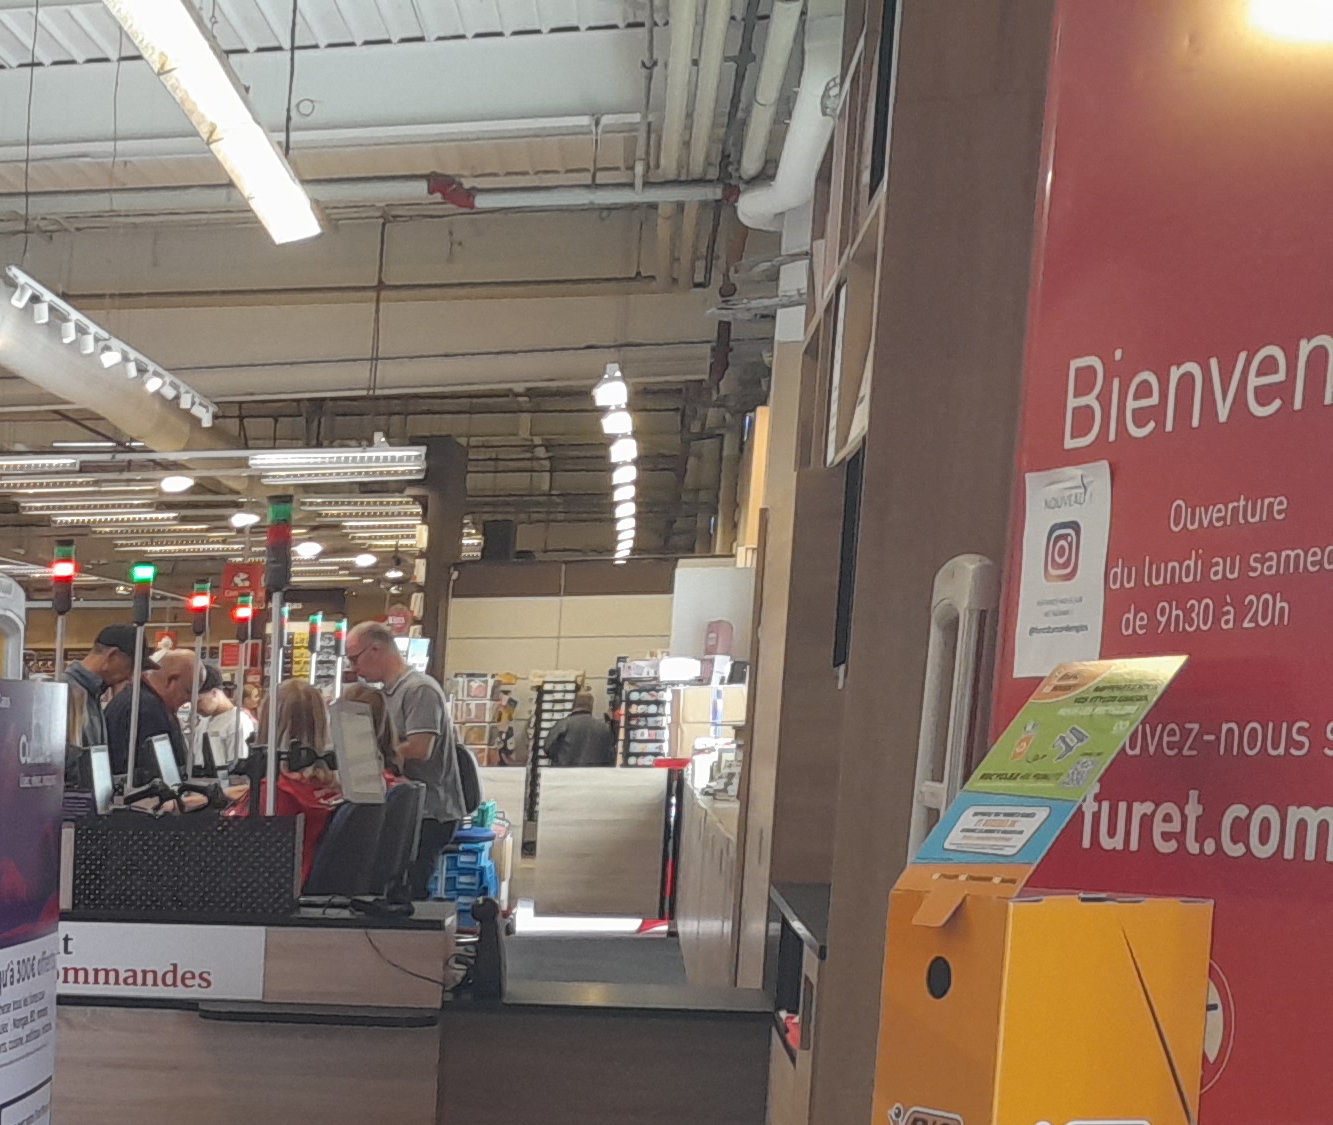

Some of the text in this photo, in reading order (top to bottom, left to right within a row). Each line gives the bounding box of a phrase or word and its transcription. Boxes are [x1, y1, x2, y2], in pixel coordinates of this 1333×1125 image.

[1169, 494, 1288, 533] Ouverture
[1109, 557, 1135, 590] du
[1144, 549, 1203, 588] lundi
[1209, 553, 1239, 582] au
[1121, 604, 1148, 637] de
[1156, 598, 1214, 634] 9h30
[1220, 595, 1235, 630] à
[1242, 592, 1289, 629] 20h
[1125, 719, 1310, 757] uvez-nous
[1082, 783, 1333, 862] furet.com
[57, 963, 212, 990] mmandes
